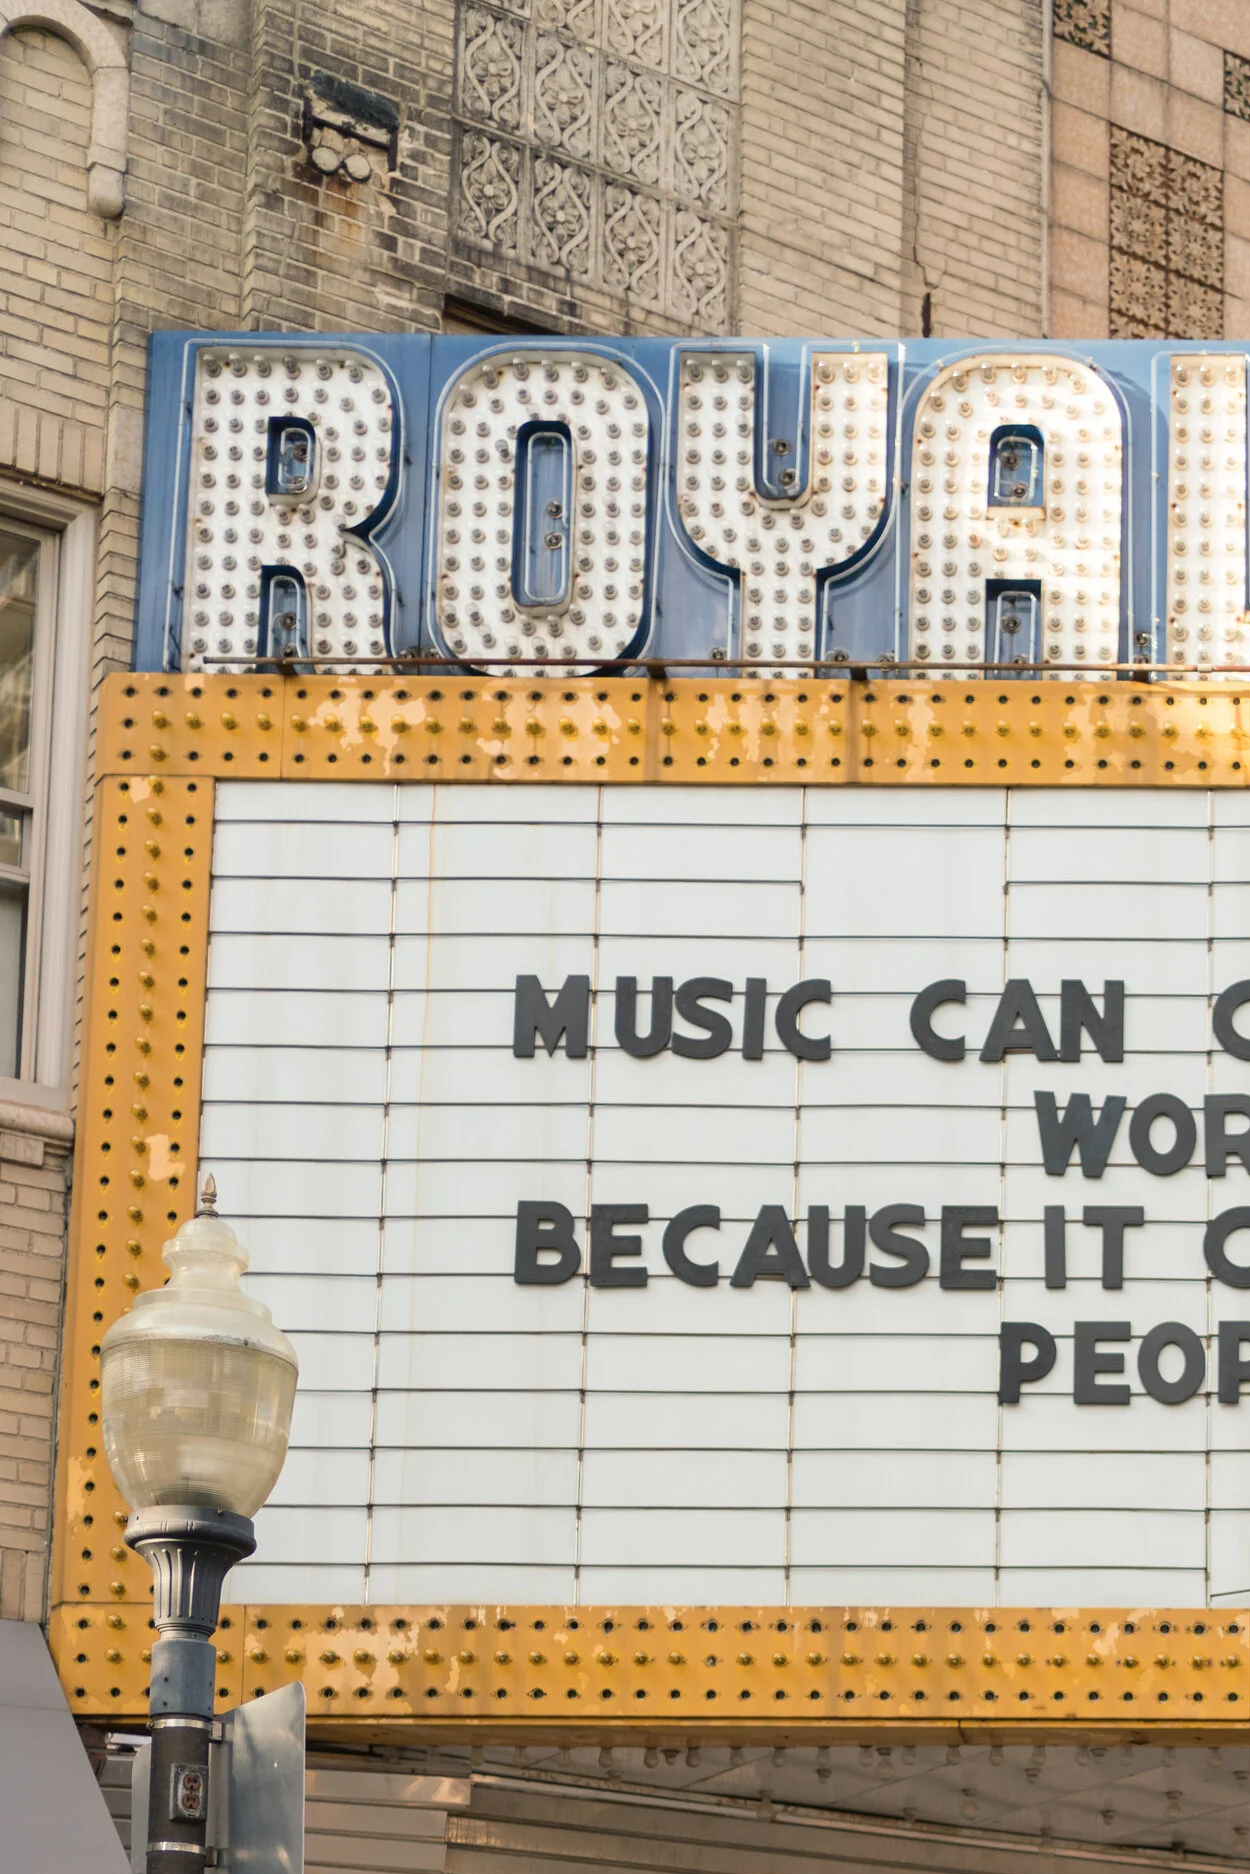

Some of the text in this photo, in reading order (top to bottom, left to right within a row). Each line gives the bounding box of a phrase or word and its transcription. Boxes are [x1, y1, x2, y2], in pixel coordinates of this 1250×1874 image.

[512, 974, 832, 1061] MUSIC
[909, 978, 1127, 1063] CAN
[512, 1200, 999, 1291] BECAUSE
[1043, 1204, 1146, 1290] IT
